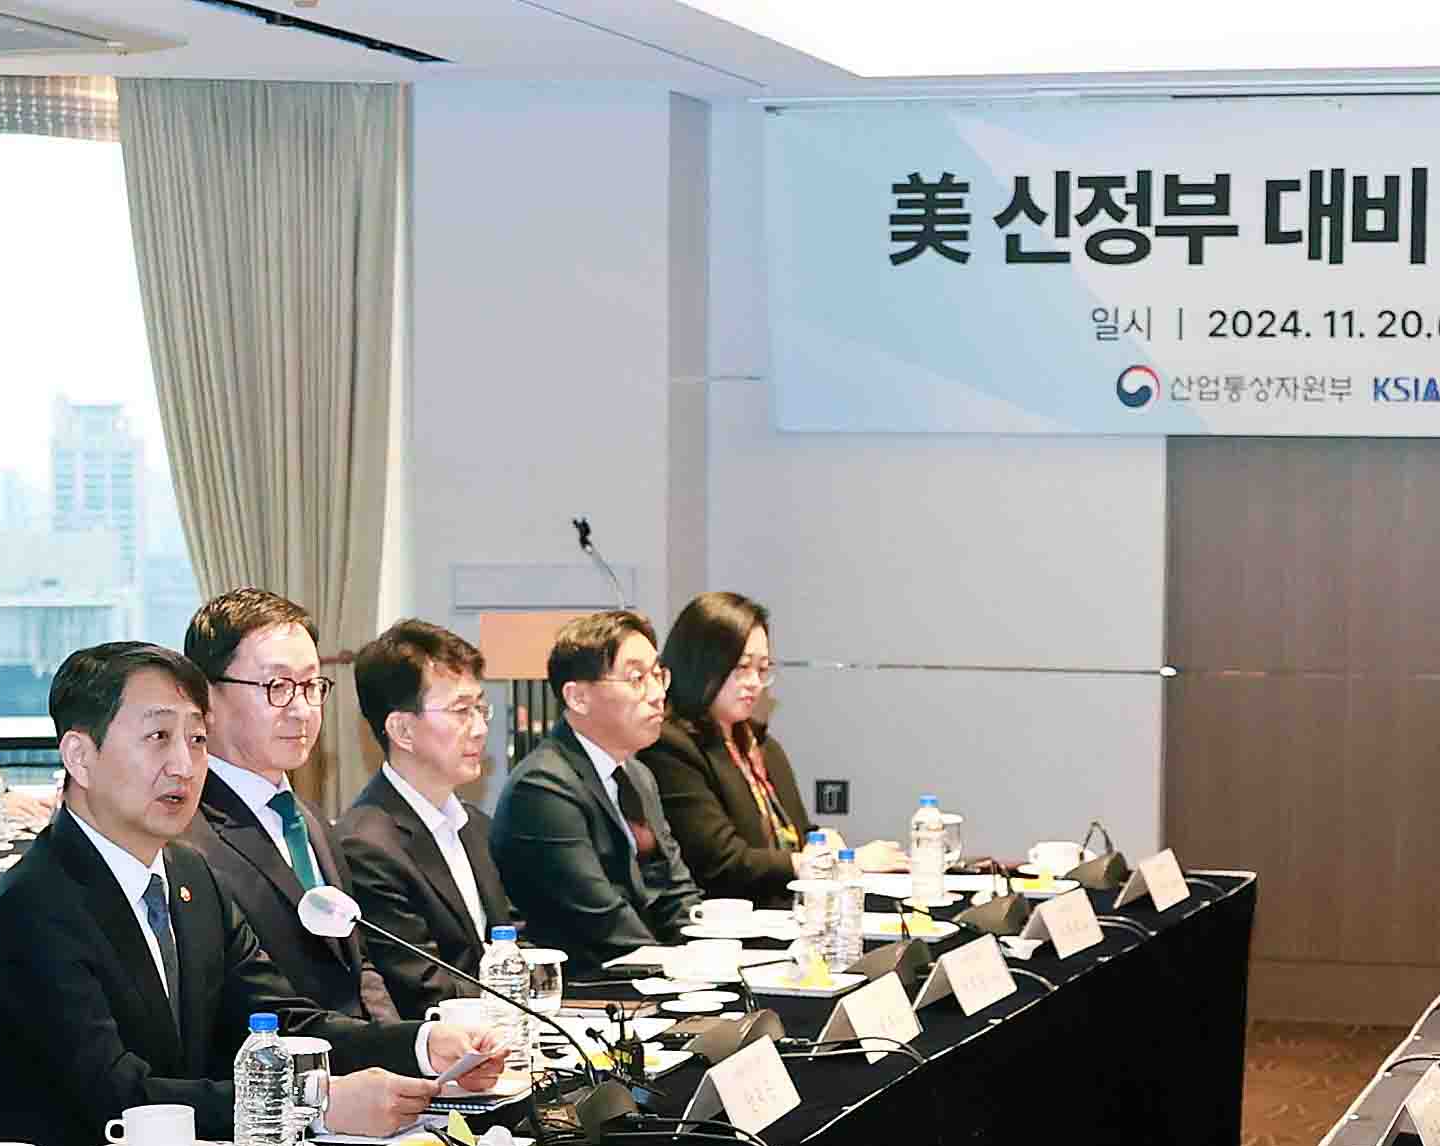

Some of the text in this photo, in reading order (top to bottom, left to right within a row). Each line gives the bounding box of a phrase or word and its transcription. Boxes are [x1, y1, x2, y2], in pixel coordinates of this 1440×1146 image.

[889, 172, 972, 266] 美
[992, 170, 1239, 266] 신정부
[1264, 168, 1428, 265] 대비
[1091, 306, 1152, 342] 일시
[1207, 309, 1312, 339] 2024.
[1323, 309, 1366, 339] 11.
[1168, 375, 1353, 404] 산업통상자원부
